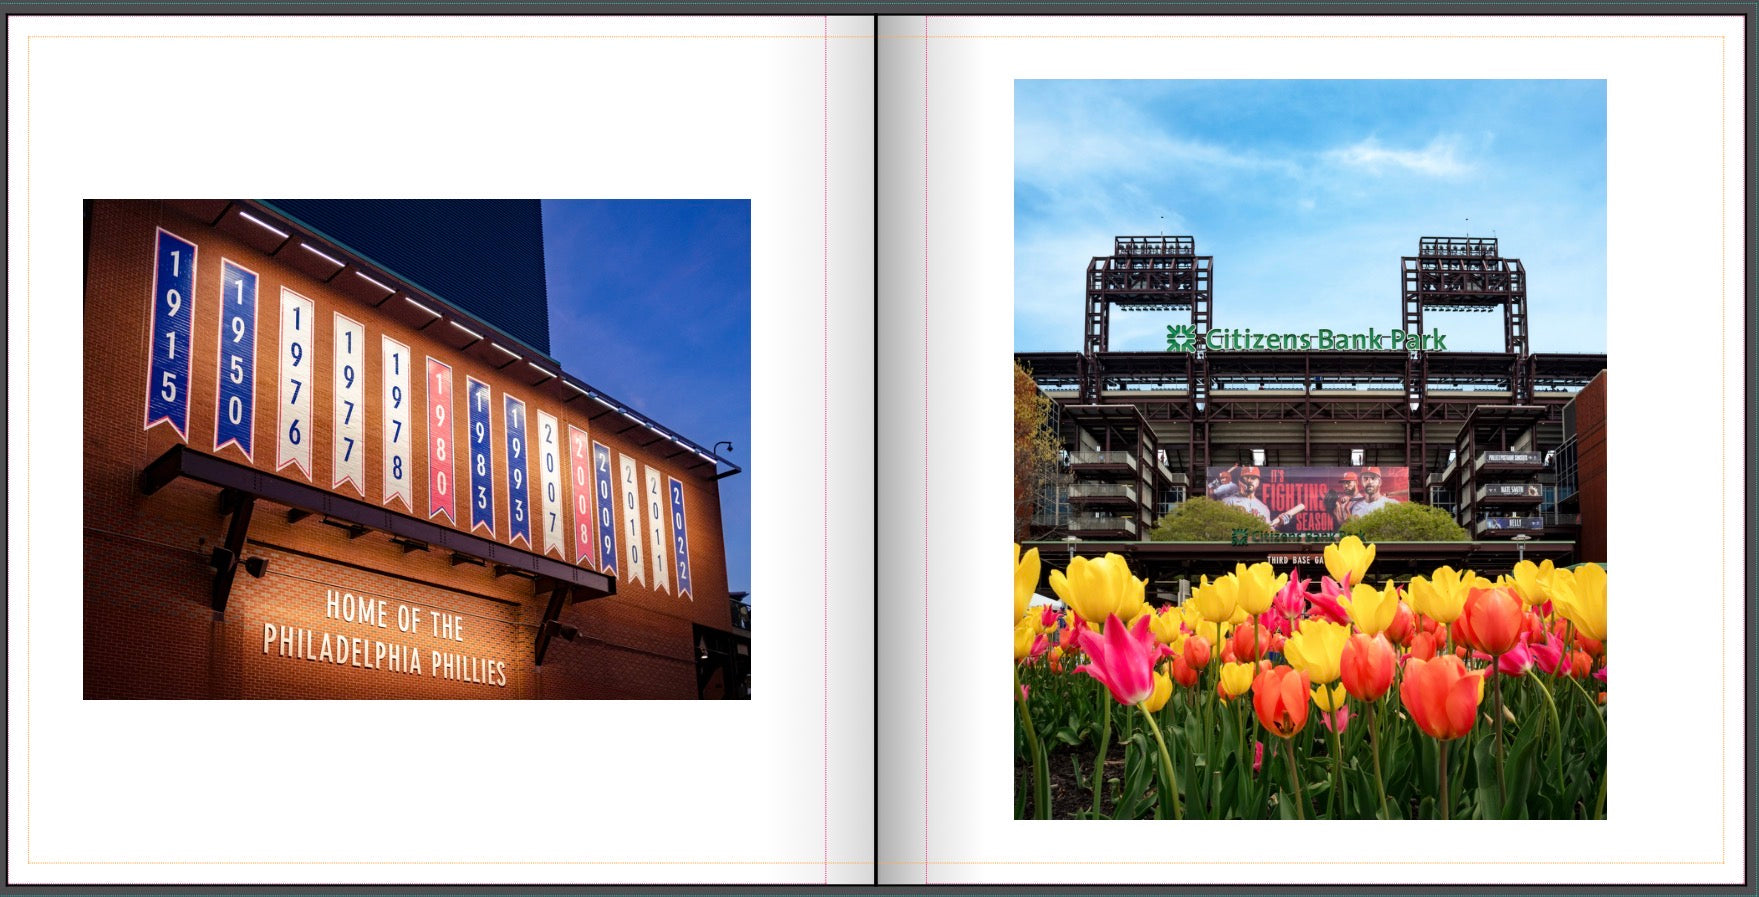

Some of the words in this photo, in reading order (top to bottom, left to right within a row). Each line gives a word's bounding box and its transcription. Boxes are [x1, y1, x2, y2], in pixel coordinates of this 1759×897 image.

[161, 250, 182, 402] 1915
[228, 279, 245, 426] 1950
[288, 306, 303, 445] 1976
[1206, 328, 1311, 350] Citizens
[1318, 327, 1383, 350] Bank
[1391, 327, 1448, 350] Park
[343, 330, 355, 462] 1977
[391, 352, 403, 480] 1978
[435, 373, 447, 496] 1980
[475, 390, 487, 510] 1983
[512, 408, 524, 522] 1993
[545, 423, 556, 533] 2007
[575, 437, 588, 544] 2008
[1262, 483, 1328, 511] FIGHTINS
[1271, 469, 1285, 483] IT'S
[599, 453, 612, 554] 2009
[626, 465, 638, 564] 2010
[650, 477, 662, 572] 2011
[673, 487, 687, 580] 2022
[1296, 512, 1334, 531] SEASON
[1267, 556, 1288, 564] THIRD
[1292, 556, 1311, 564] BASE
[1314, 556, 1324, 564] GA
[263, 623, 422, 675] PHILADELPHIA
[432, 650, 507, 687] PHILLIES
[327, 589, 387, 628] HOME
[398, 604, 421, 634] OF
[430, 611, 464, 642] THE
